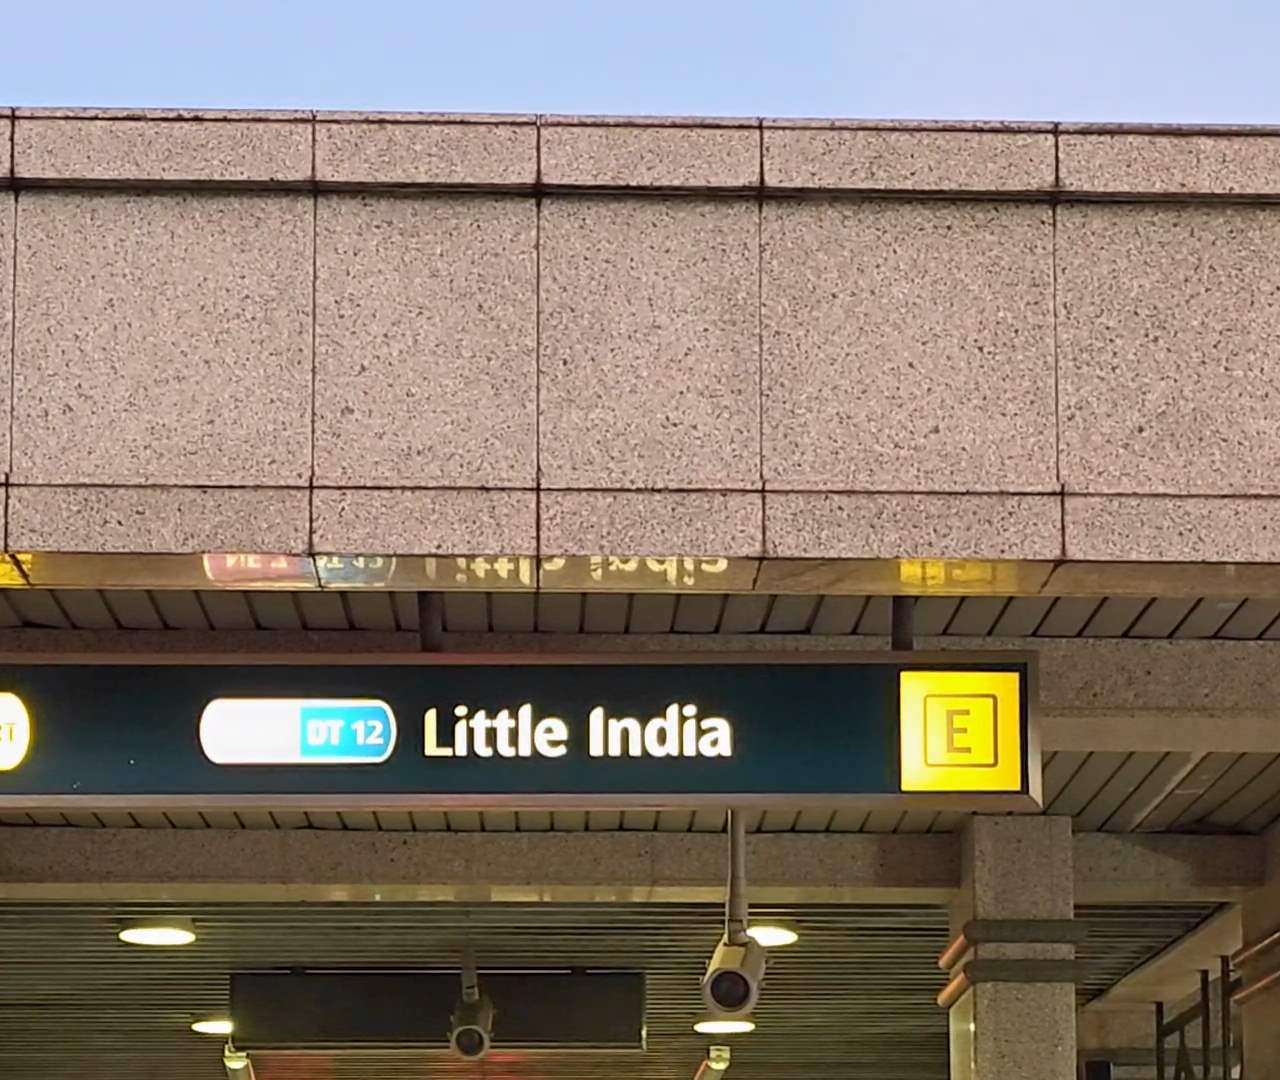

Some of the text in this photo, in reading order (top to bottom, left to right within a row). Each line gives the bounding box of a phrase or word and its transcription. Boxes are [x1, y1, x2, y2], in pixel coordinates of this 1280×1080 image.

[307, 721, 384, 745] DT 12
[423, 703, 733, 758] Little India
[945, 708, 972, 755] E
